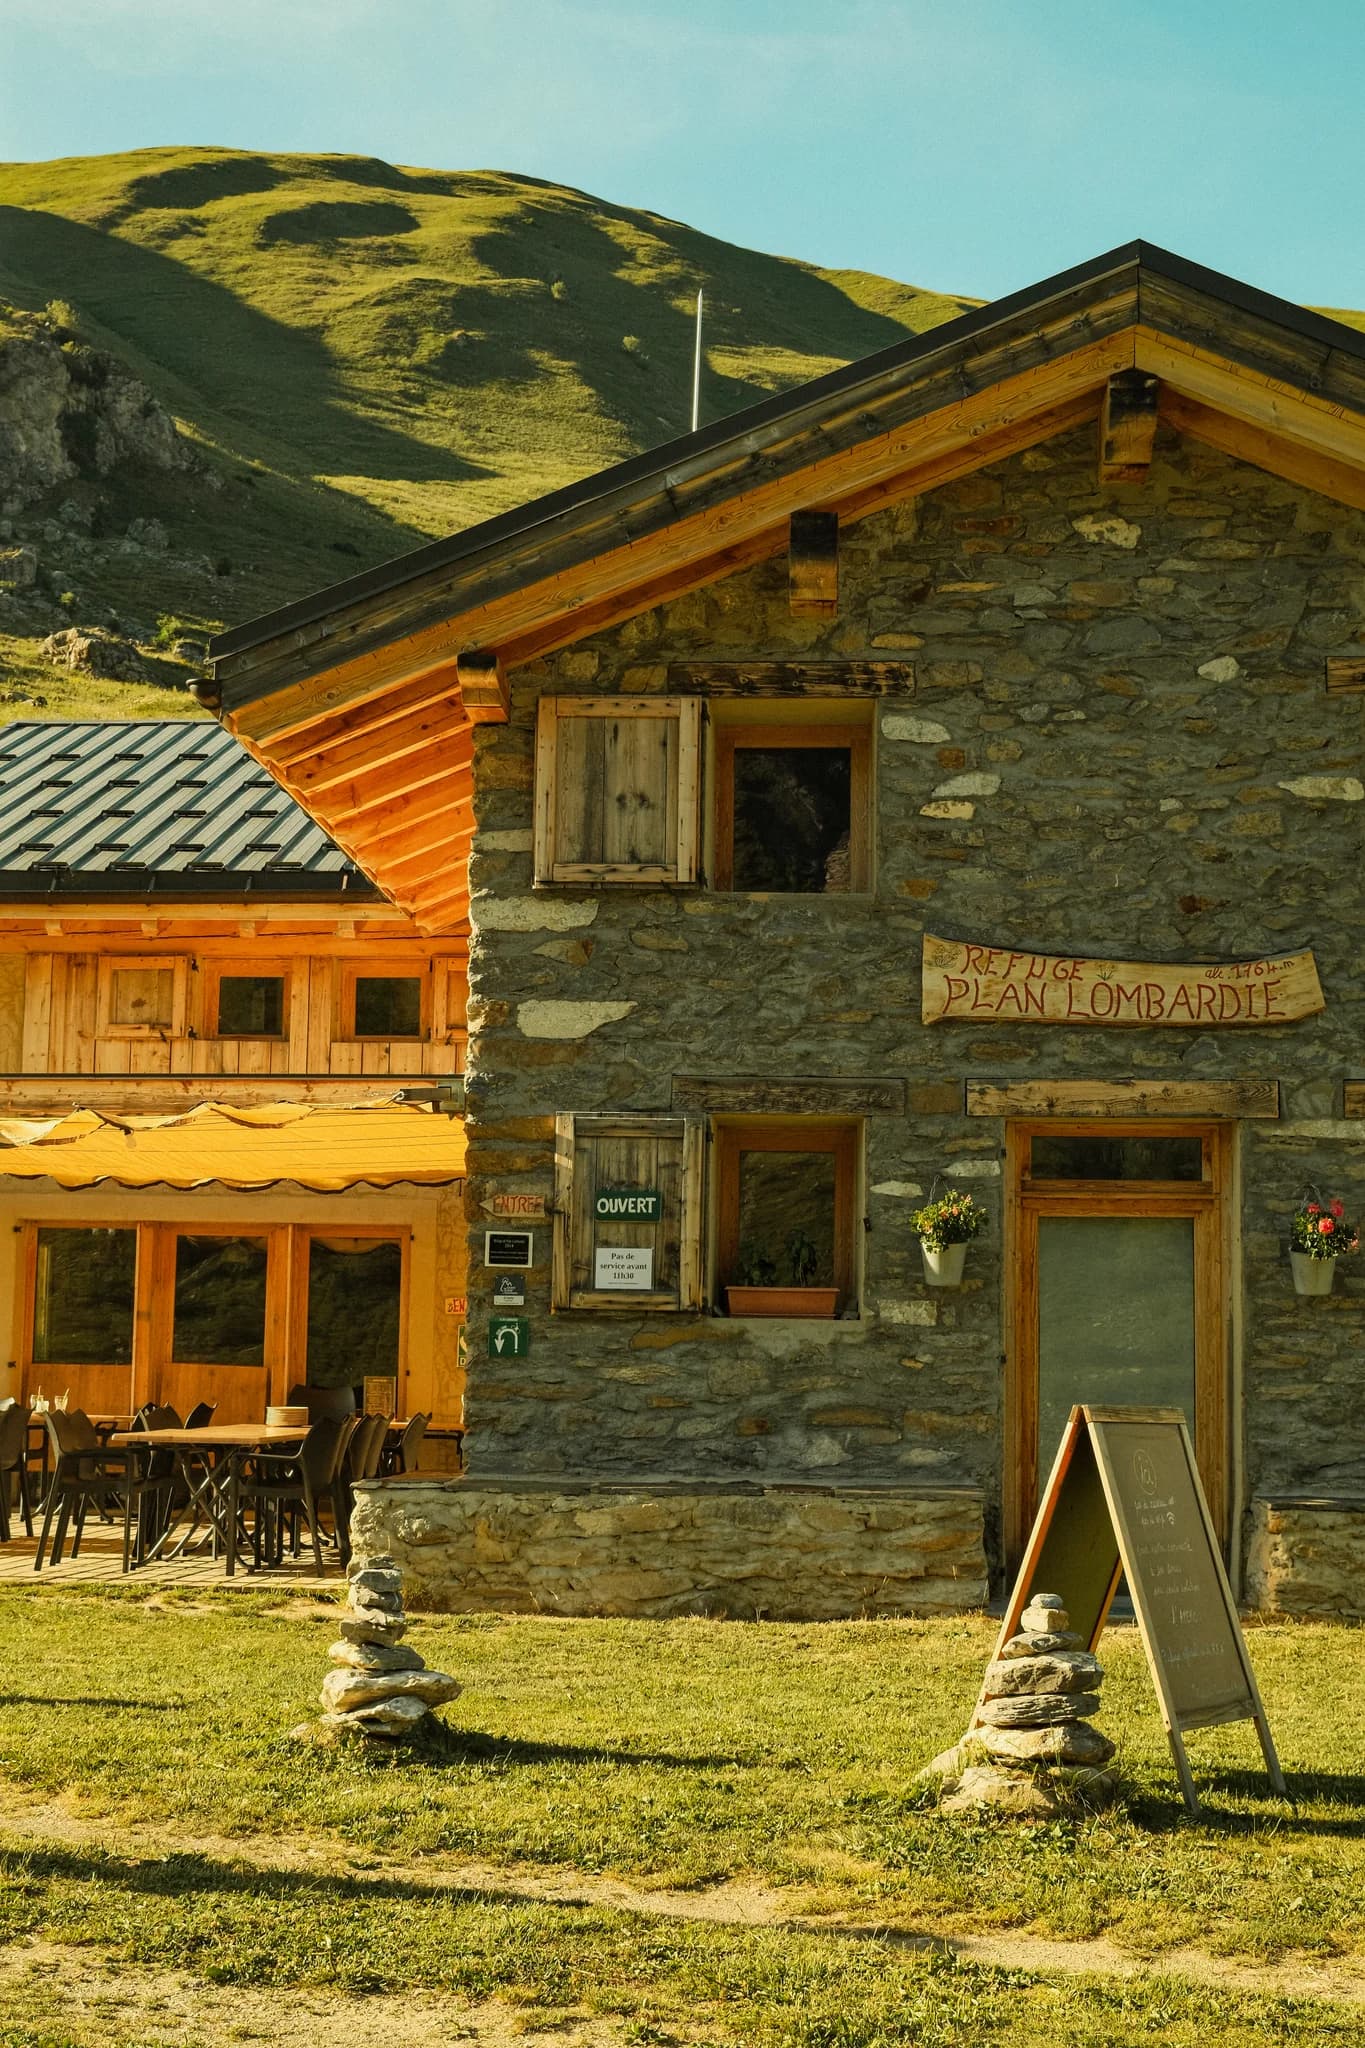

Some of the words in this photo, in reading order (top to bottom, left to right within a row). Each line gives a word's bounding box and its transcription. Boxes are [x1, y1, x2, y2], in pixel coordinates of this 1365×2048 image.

[961, 945, 1086, 981] REFUGE
[943, 975, 1047, 1014] PLAN
[1067, 979, 1285, 1020] LOMBARDIE
[597, 1198, 656, 1213] OUVERT
[611, 1252, 624, 1260] Pas
[625, 1252, 635, 1260] de
[600, 1262, 625, 1270] service
[626, 1262, 647, 1270] avant
[613, 1272, 634, 1280] 11h30
